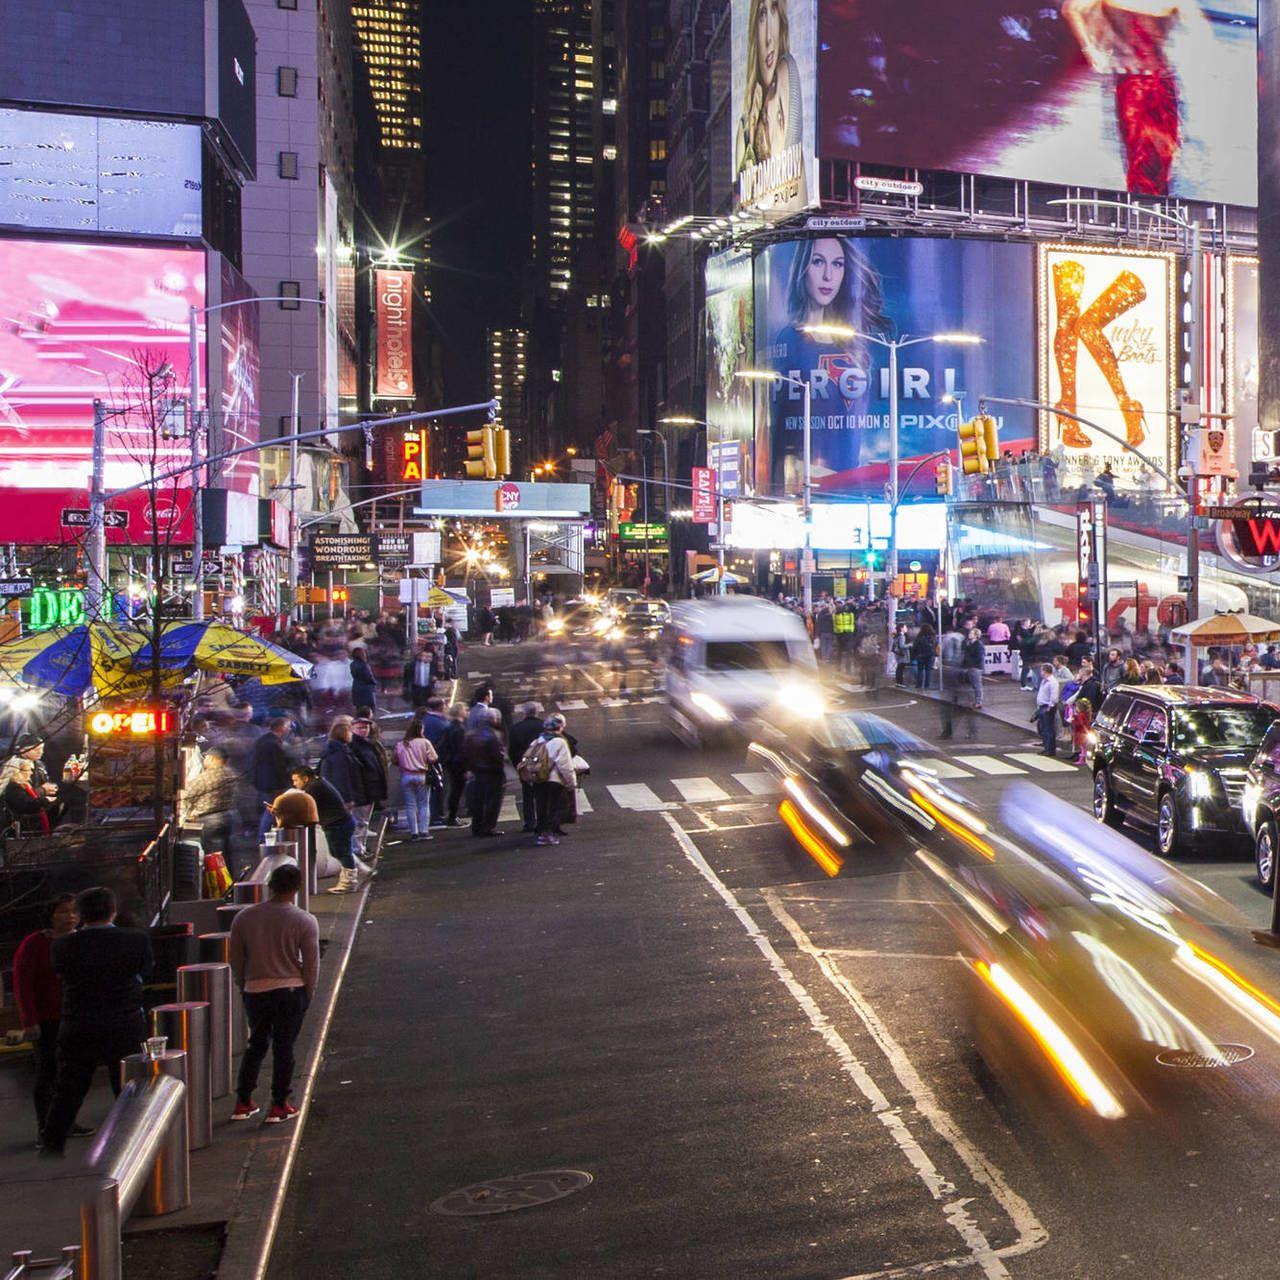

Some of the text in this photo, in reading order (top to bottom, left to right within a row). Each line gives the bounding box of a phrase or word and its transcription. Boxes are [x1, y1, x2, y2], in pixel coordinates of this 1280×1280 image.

[861, 178, 919, 191] city outdoor
[812, 218, 862, 228] city outdoor
[827, 417, 845, 430] OCT
[858, 416, 880, 429] MON
[1103, 455, 1125, 466] TONY
[1128, 455, 1164, 467] AWDS
[315, 536, 371, 545] ASTONISHING!
[315, 545, 371, 553] WONDROUS!
